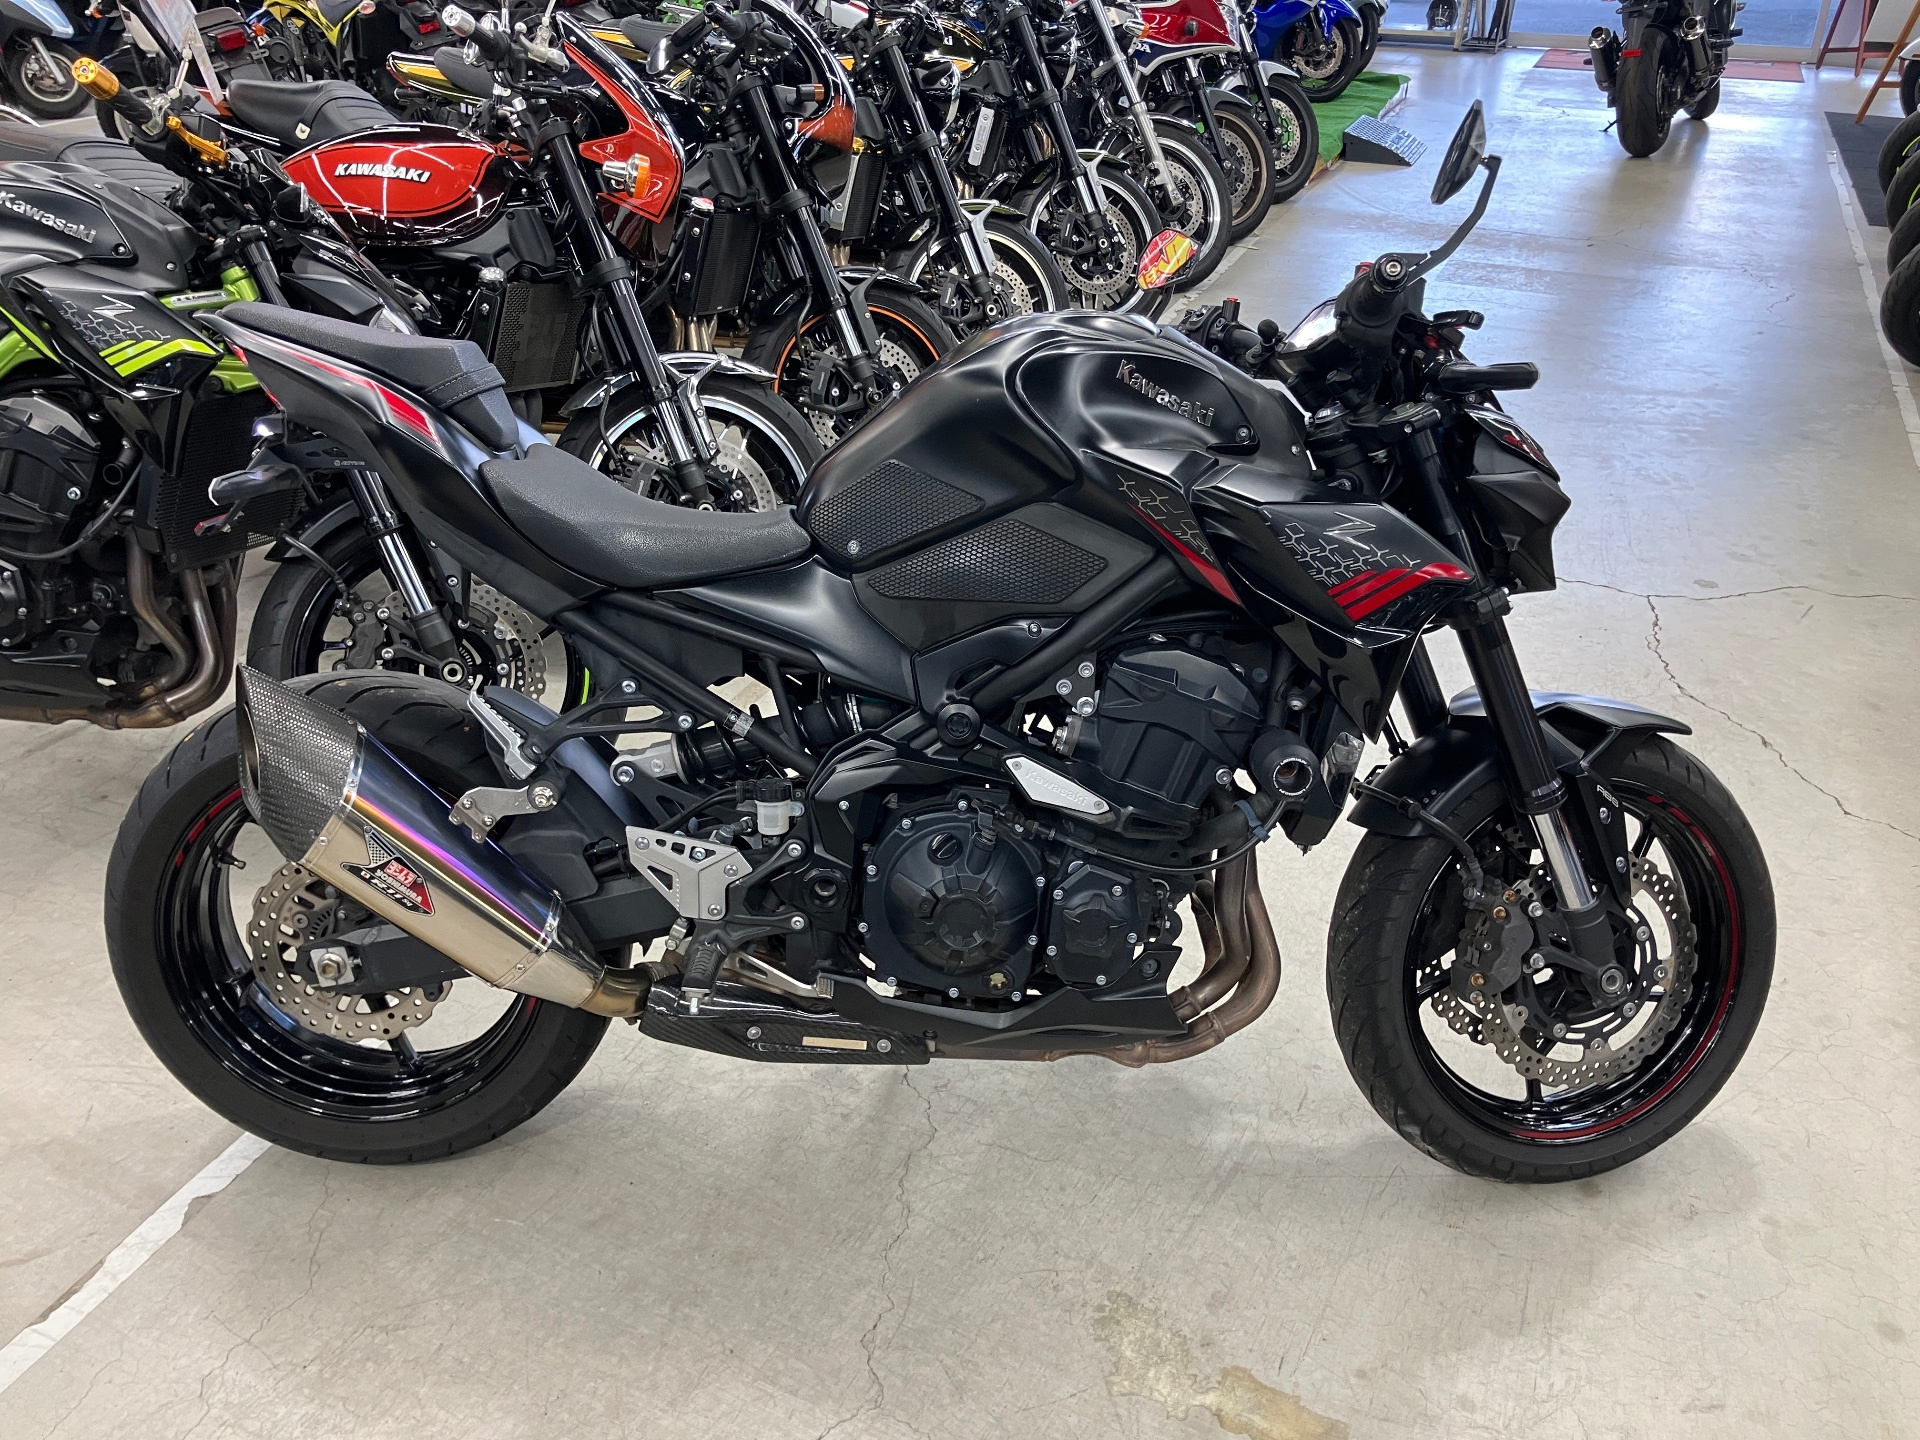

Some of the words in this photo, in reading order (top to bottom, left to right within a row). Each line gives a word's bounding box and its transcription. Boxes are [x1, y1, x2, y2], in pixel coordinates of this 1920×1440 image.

[334, 163, 431, 183] KAWASAKI
[0, 190, 97, 244] Kawasaki
[1116, 359, 1215, 427] Kawasaki
[1025, 768, 1089, 806] Kawasaki
[1596, 784, 1619, 808] ABS
[375, 869, 422, 903] YOSHIMURA
[385, 861, 417, 887] ヨシムラ
